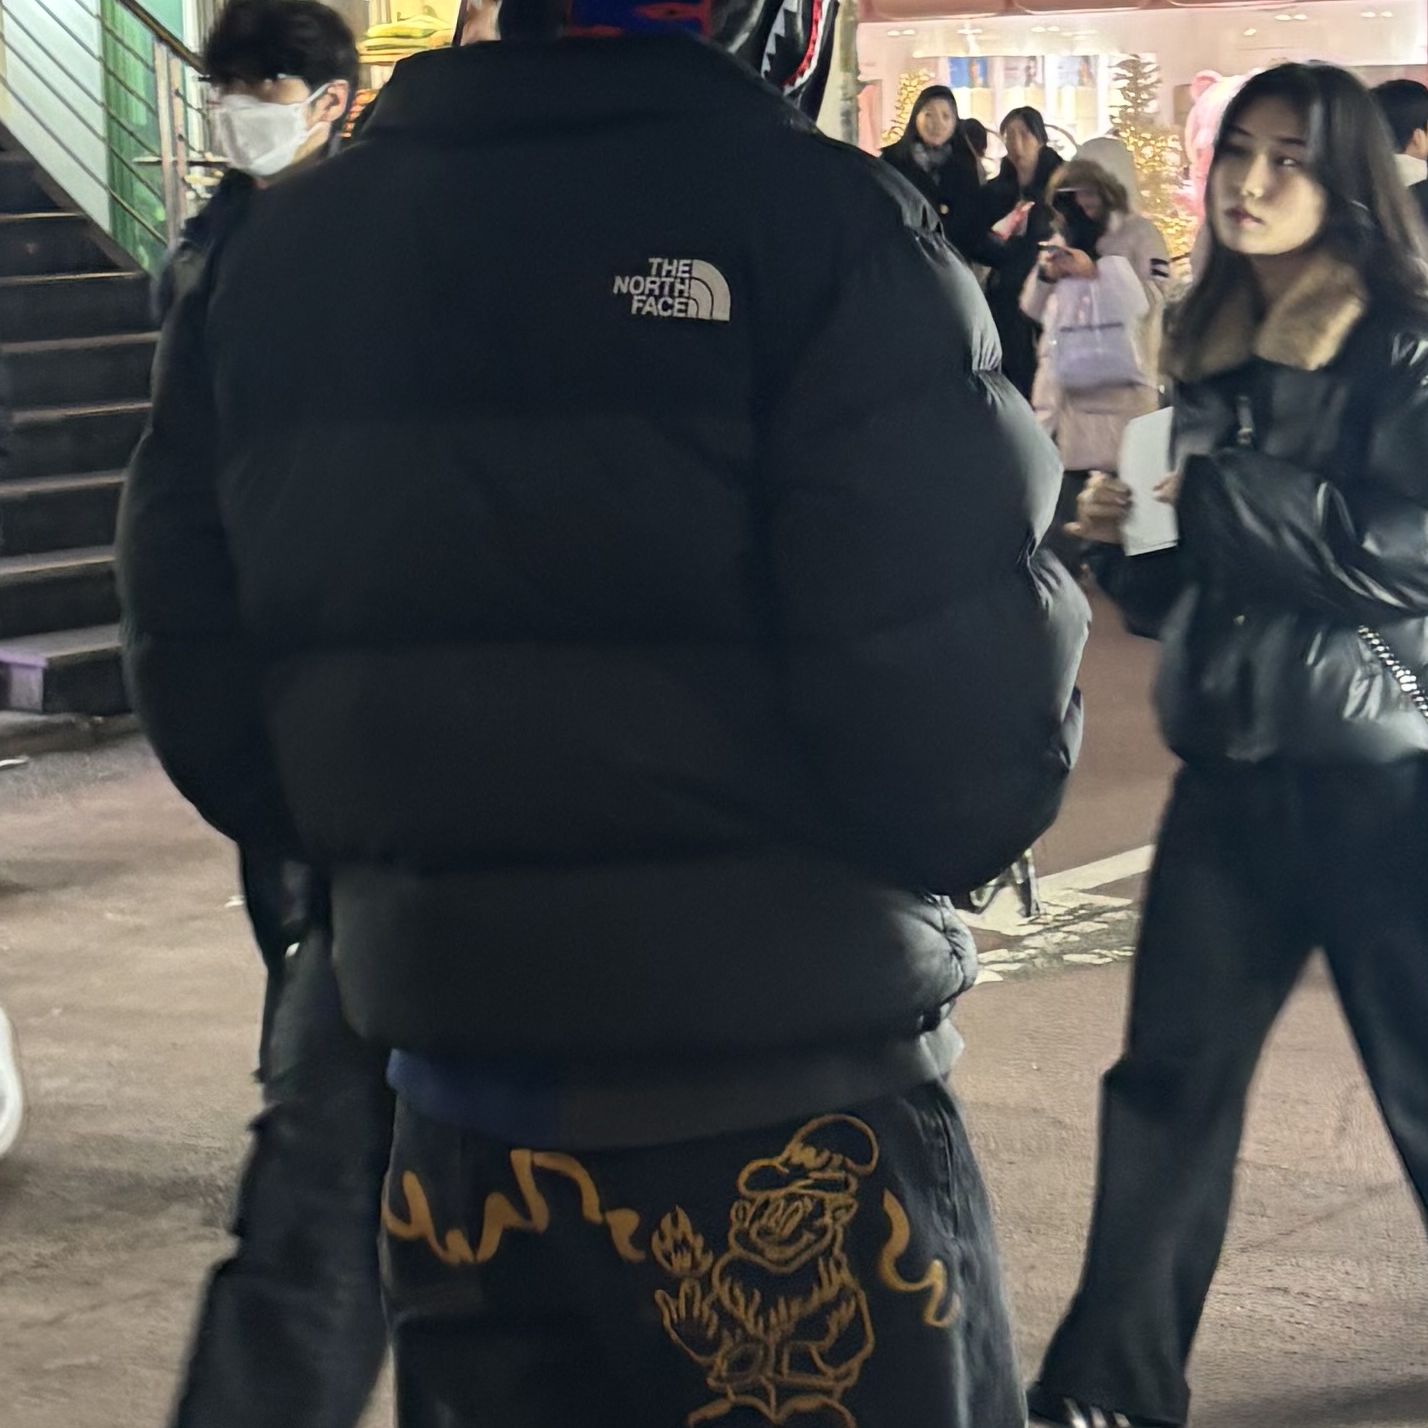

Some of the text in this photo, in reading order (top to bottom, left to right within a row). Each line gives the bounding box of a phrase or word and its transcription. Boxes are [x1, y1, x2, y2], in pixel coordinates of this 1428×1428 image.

[648, 257, 692, 278] THE
[612, 275, 690, 297] NORTH
[631, 294, 689, 318] FACE
